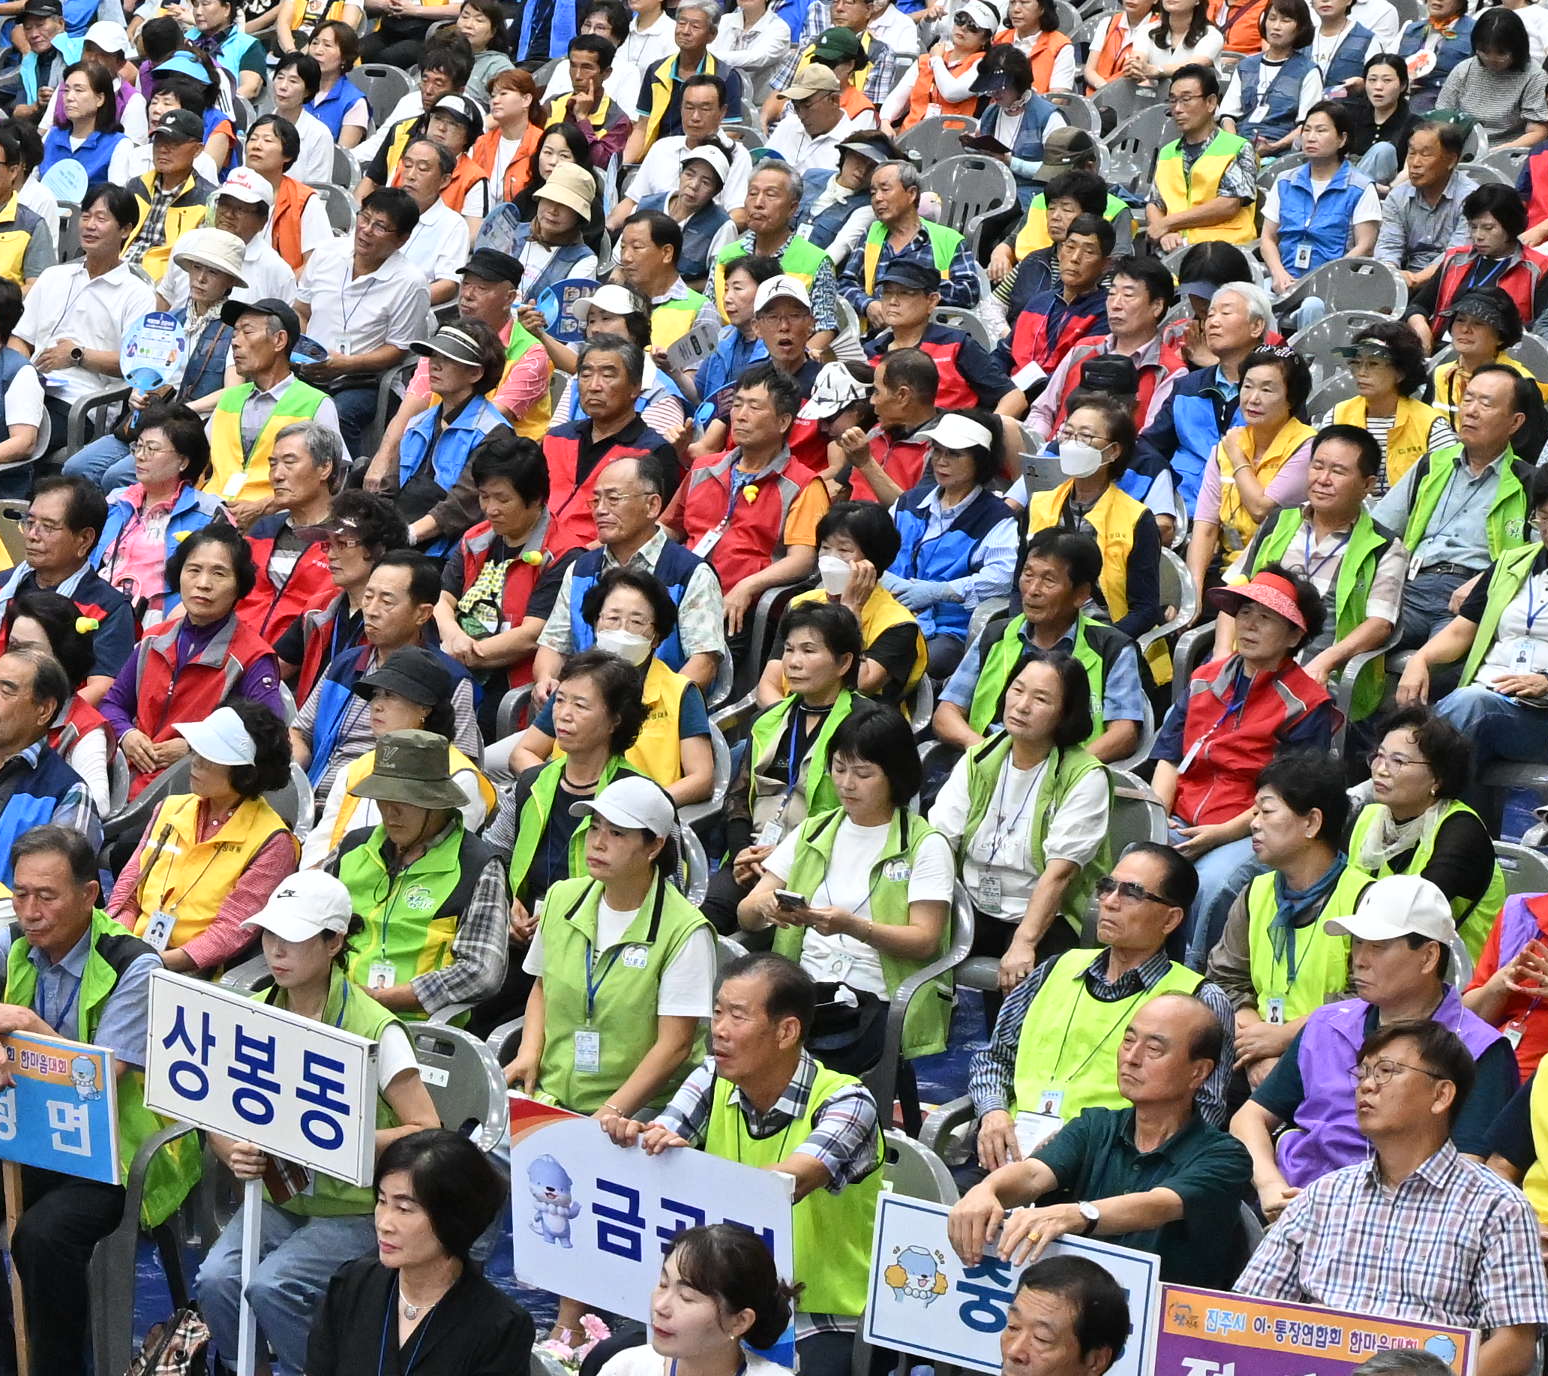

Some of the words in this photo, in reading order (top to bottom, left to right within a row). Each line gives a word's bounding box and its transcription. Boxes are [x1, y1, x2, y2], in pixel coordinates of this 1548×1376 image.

[20, 1049, 67, 1074] 한마음대회
[162, 1005, 351, 1151] 상봉동
[1205, 1308, 1245, 1336] 진주시
[1253, 1316, 1342, 1349] 이·통장연합회
